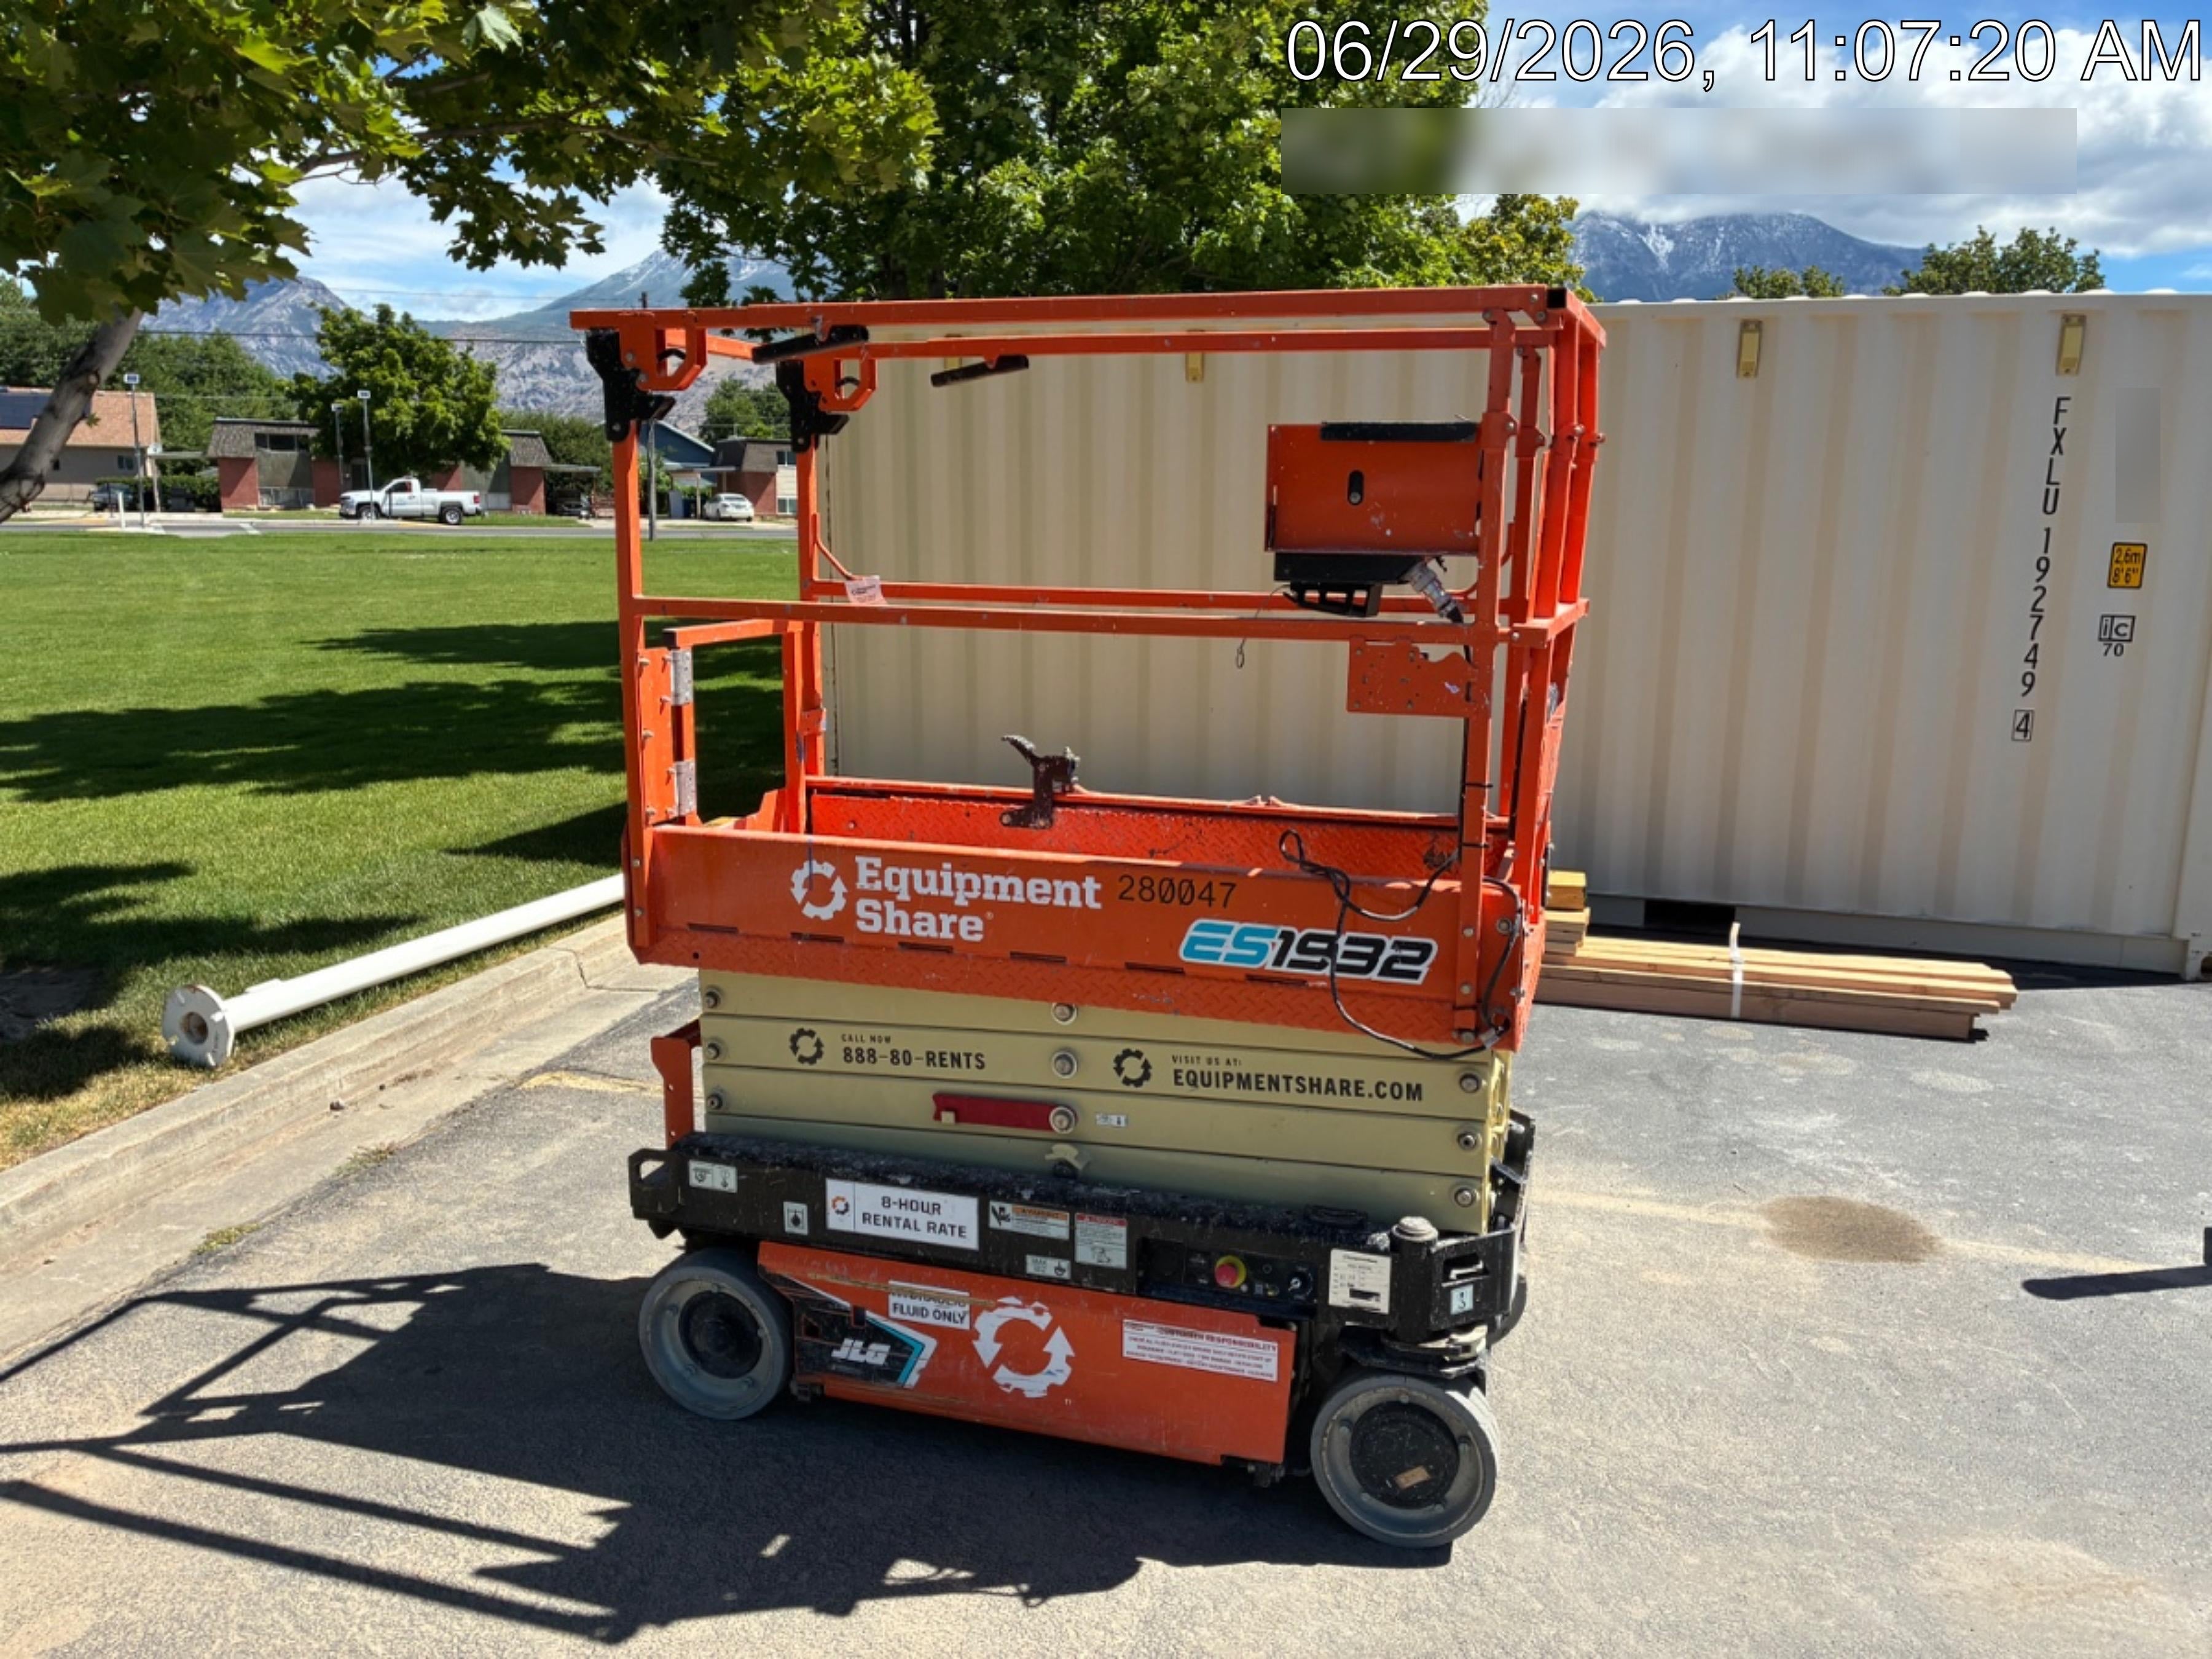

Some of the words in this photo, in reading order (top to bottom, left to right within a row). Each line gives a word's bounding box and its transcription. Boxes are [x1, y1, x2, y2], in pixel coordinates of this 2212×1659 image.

[2042, 396, 2072, 516] FXLU
[2021, 527, 2052, 698] 192749
[2103, 643, 2124, 657] 70
[2015, 712, 2031, 739] 4
[855, 855, 1102, 909] Equipment
[1118, 874, 1237, 909] 280047
[855, 898, 984, 943] Share
[1181, 919, 1436, 983] ES1932
[841, 1033, 866, 1043] CALL
[869, 1035, 892, 1044] NOW
[842, 1046, 986, 1070] 888-80-RENTS
[1171, 1054, 1202, 1065] VISIT
[1206, 1057, 1220, 1065] US
[1225, 1057, 1242, 1067] AT:
[1173, 1068, 1424, 1102] EQUIPMENTSHARE.COM
[881, 1196, 941, 1215] 8-HOUR
[862, 1212, 921, 1232] RENTAL
[926, 1220, 967, 1239] RATE
[893, 1302, 929, 1319] FLUID
[932, 1308, 967, 1325] ONLY
[830, 1338, 891, 1365] JLG
